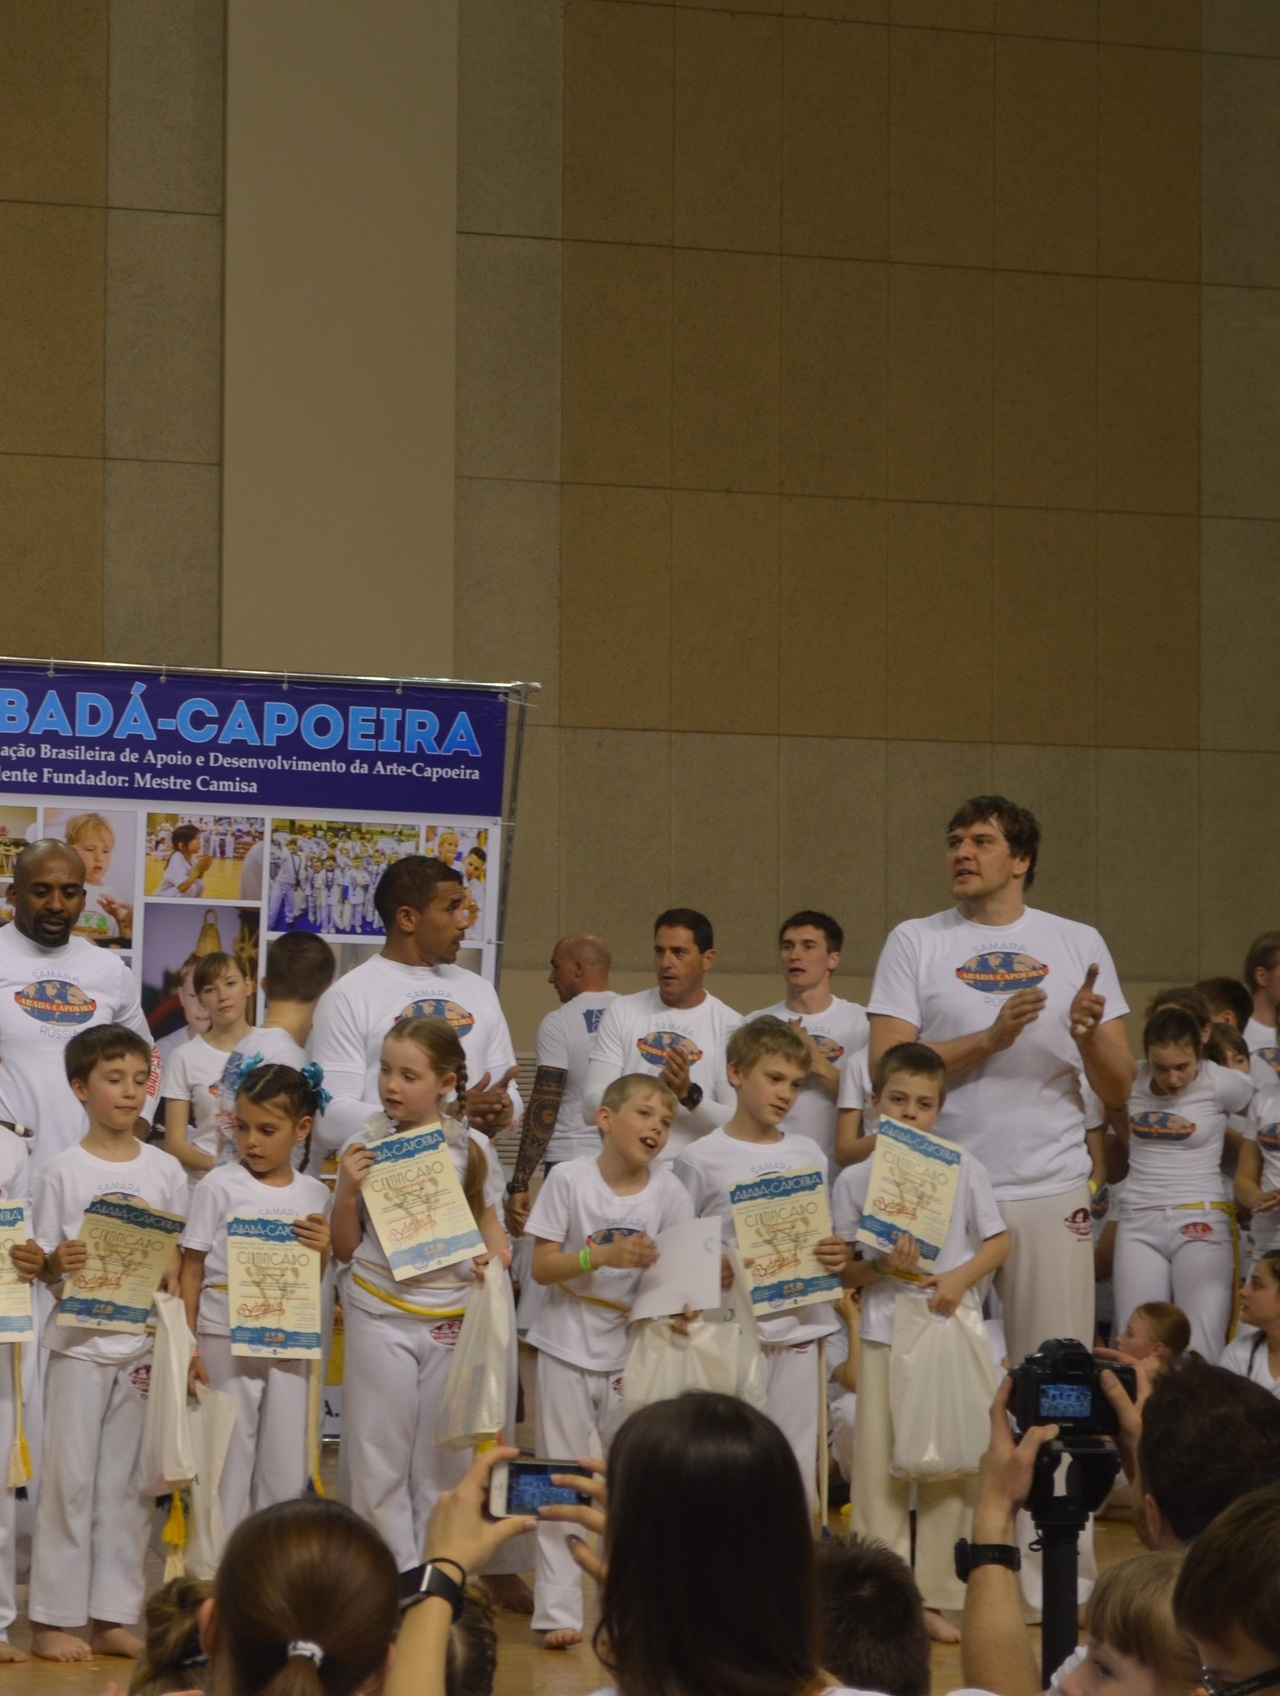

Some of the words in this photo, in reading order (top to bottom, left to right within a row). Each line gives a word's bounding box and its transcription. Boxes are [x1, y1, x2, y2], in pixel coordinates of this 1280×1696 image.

[40, 744, 116, 762] Brasileira
[120, 747, 139, 763] de
[143, 749, 192, 768] Apoio
[196, 755, 205, 766] e
[209, 752, 346, 774] Desenvolvimento
[350, 759, 369, 774] da
[373, 760, 480, 782] Arte-Capoeira
[42, 768, 129, 787] Fundador:
[133, 772, 192, 791] Mestre
[196, 775, 258, 794] Camisa
[972, 942, 1027, 954] SAMARA
[32, 970, 81, 985] SAMARA
[407, 990, 453, 1001] SAMARA
[97, 1182, 142, 1193] SAMARA
[370, 1161, 445, 1193] CERTIFICADO
[744, 1201, 818, 1228] CERTIFICADO
[88, 1227, 165, 1252] CERTIFICADO
[236, 1251, 310, 1268] CERTIFICADO
